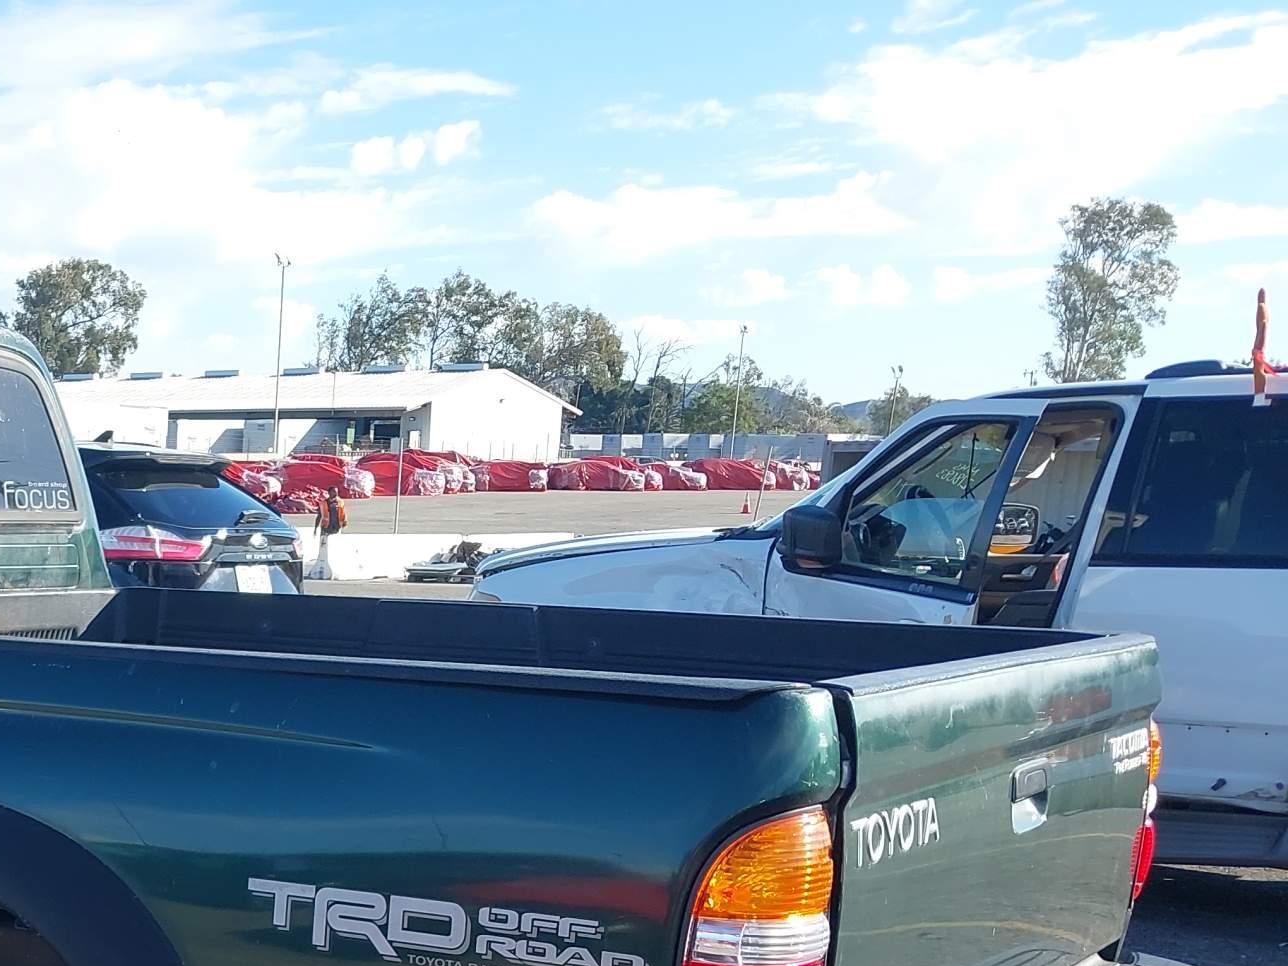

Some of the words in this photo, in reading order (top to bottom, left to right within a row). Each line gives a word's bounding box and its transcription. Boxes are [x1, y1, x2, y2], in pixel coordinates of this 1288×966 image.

[850, 797, 940, 868] TOYOTA
[248, 878, 471, 962] TRD
[478, 907, 605, 943] OFF
